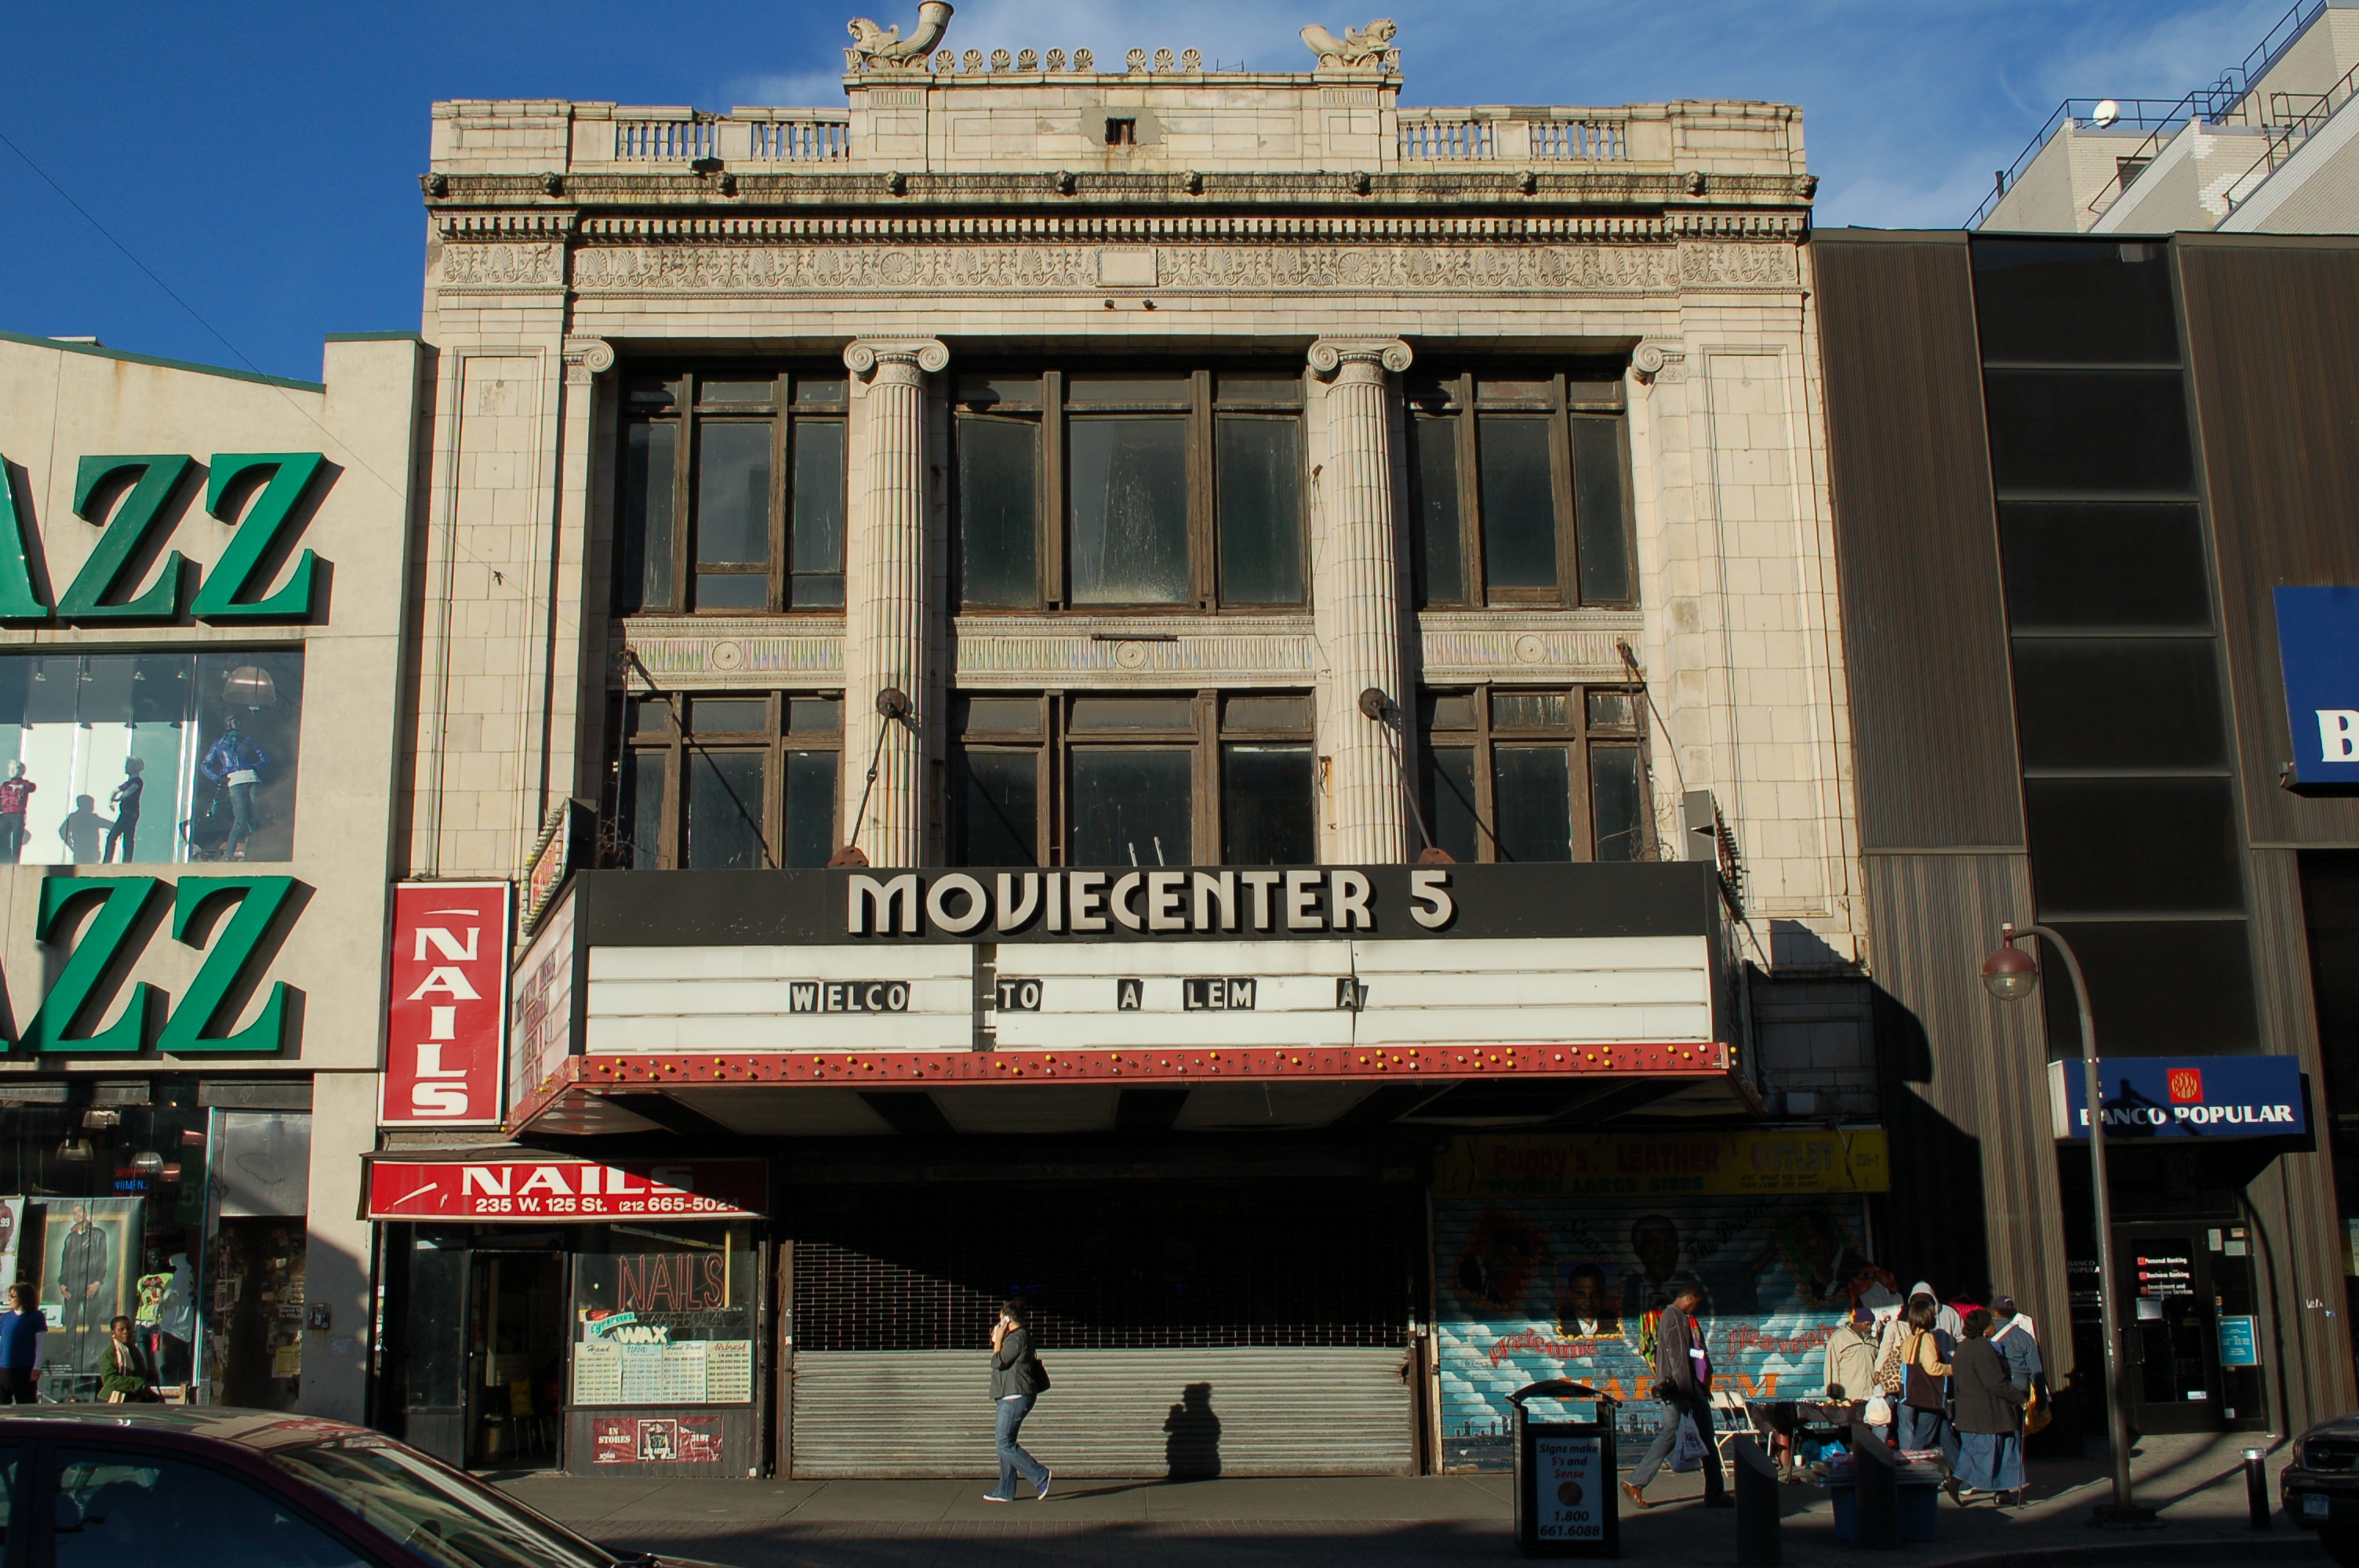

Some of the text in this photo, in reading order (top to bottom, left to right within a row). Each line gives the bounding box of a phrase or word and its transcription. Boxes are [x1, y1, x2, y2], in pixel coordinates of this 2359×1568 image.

[847, 870, 1456, 936] MOVIECENTER 5
[0, 876, 296, 1057] ZZ
[791, 982, 907, 1011] WELCO
[998, 981, 1041, 1010] TO
[1119, 981, 1141, 1010] A
[1186, 981, 1253, 1010] LEM
[406, 927, 482, 1116] NAILS
[2173, 1105, 2295, 1124] POPULAR
[1618, 1142, 1720, 1173] LEATHER
[1750, 1141, 1834, 1171] OUTLET
[461, 1166, 694, 1196] NAILS
[1573, 1178, 1638, 1192] LARGE
[1649, 1176, 1704, 1191] SIZES
[475, 1197, 740, 1213] 235 W. 125 St. (212 665-5024
[617, 1253, 725, 1312] NAILS
[617, 1325, 668, 1344] WAX
[1488, 1327, 1599, 1369] Welcome
[598, 1435, 631, 1444] STORES
[609, 1427, 619, 1436] IN
[1539, 1443, 1598, 1455] Signs make
[1567, 1457, 1587, 1465] and
[1554, 1469, 1584, 1479] Sense
[1554, 1511, 1590, 1522] 1.800
[1539, 1525, 1600, 1537] 661.6088
